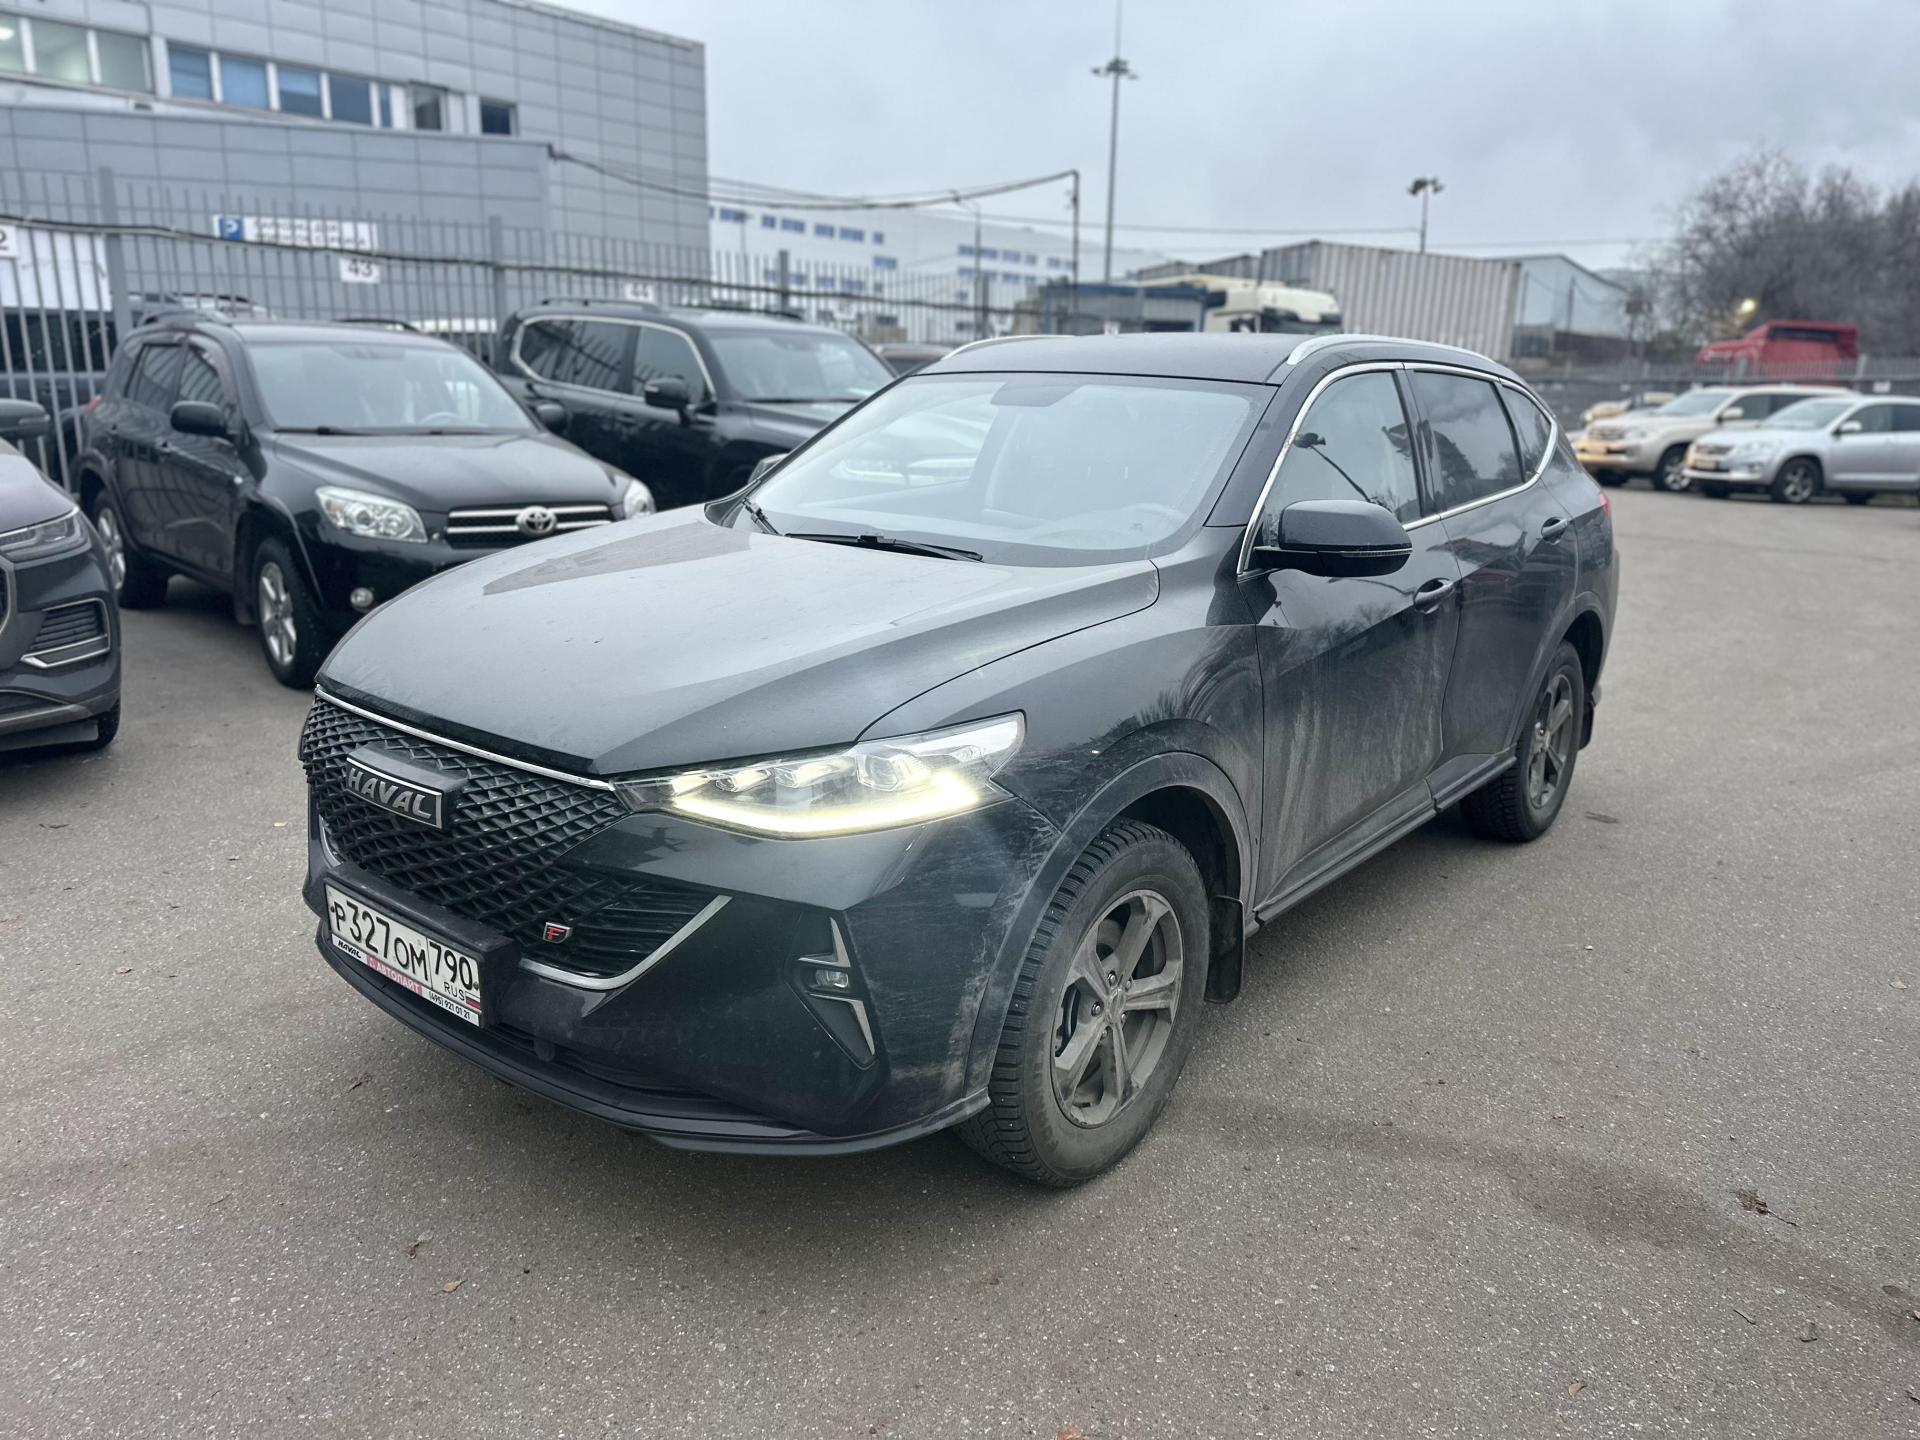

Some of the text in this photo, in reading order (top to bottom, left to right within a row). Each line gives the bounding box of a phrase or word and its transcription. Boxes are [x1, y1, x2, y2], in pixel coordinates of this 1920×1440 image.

[348, 257, 373, 277] 43
[348, 767, 432, 819] HAVAL
[337, 939, 362, 959] HAVAL
[443, 981, 465, 1001] RUS
